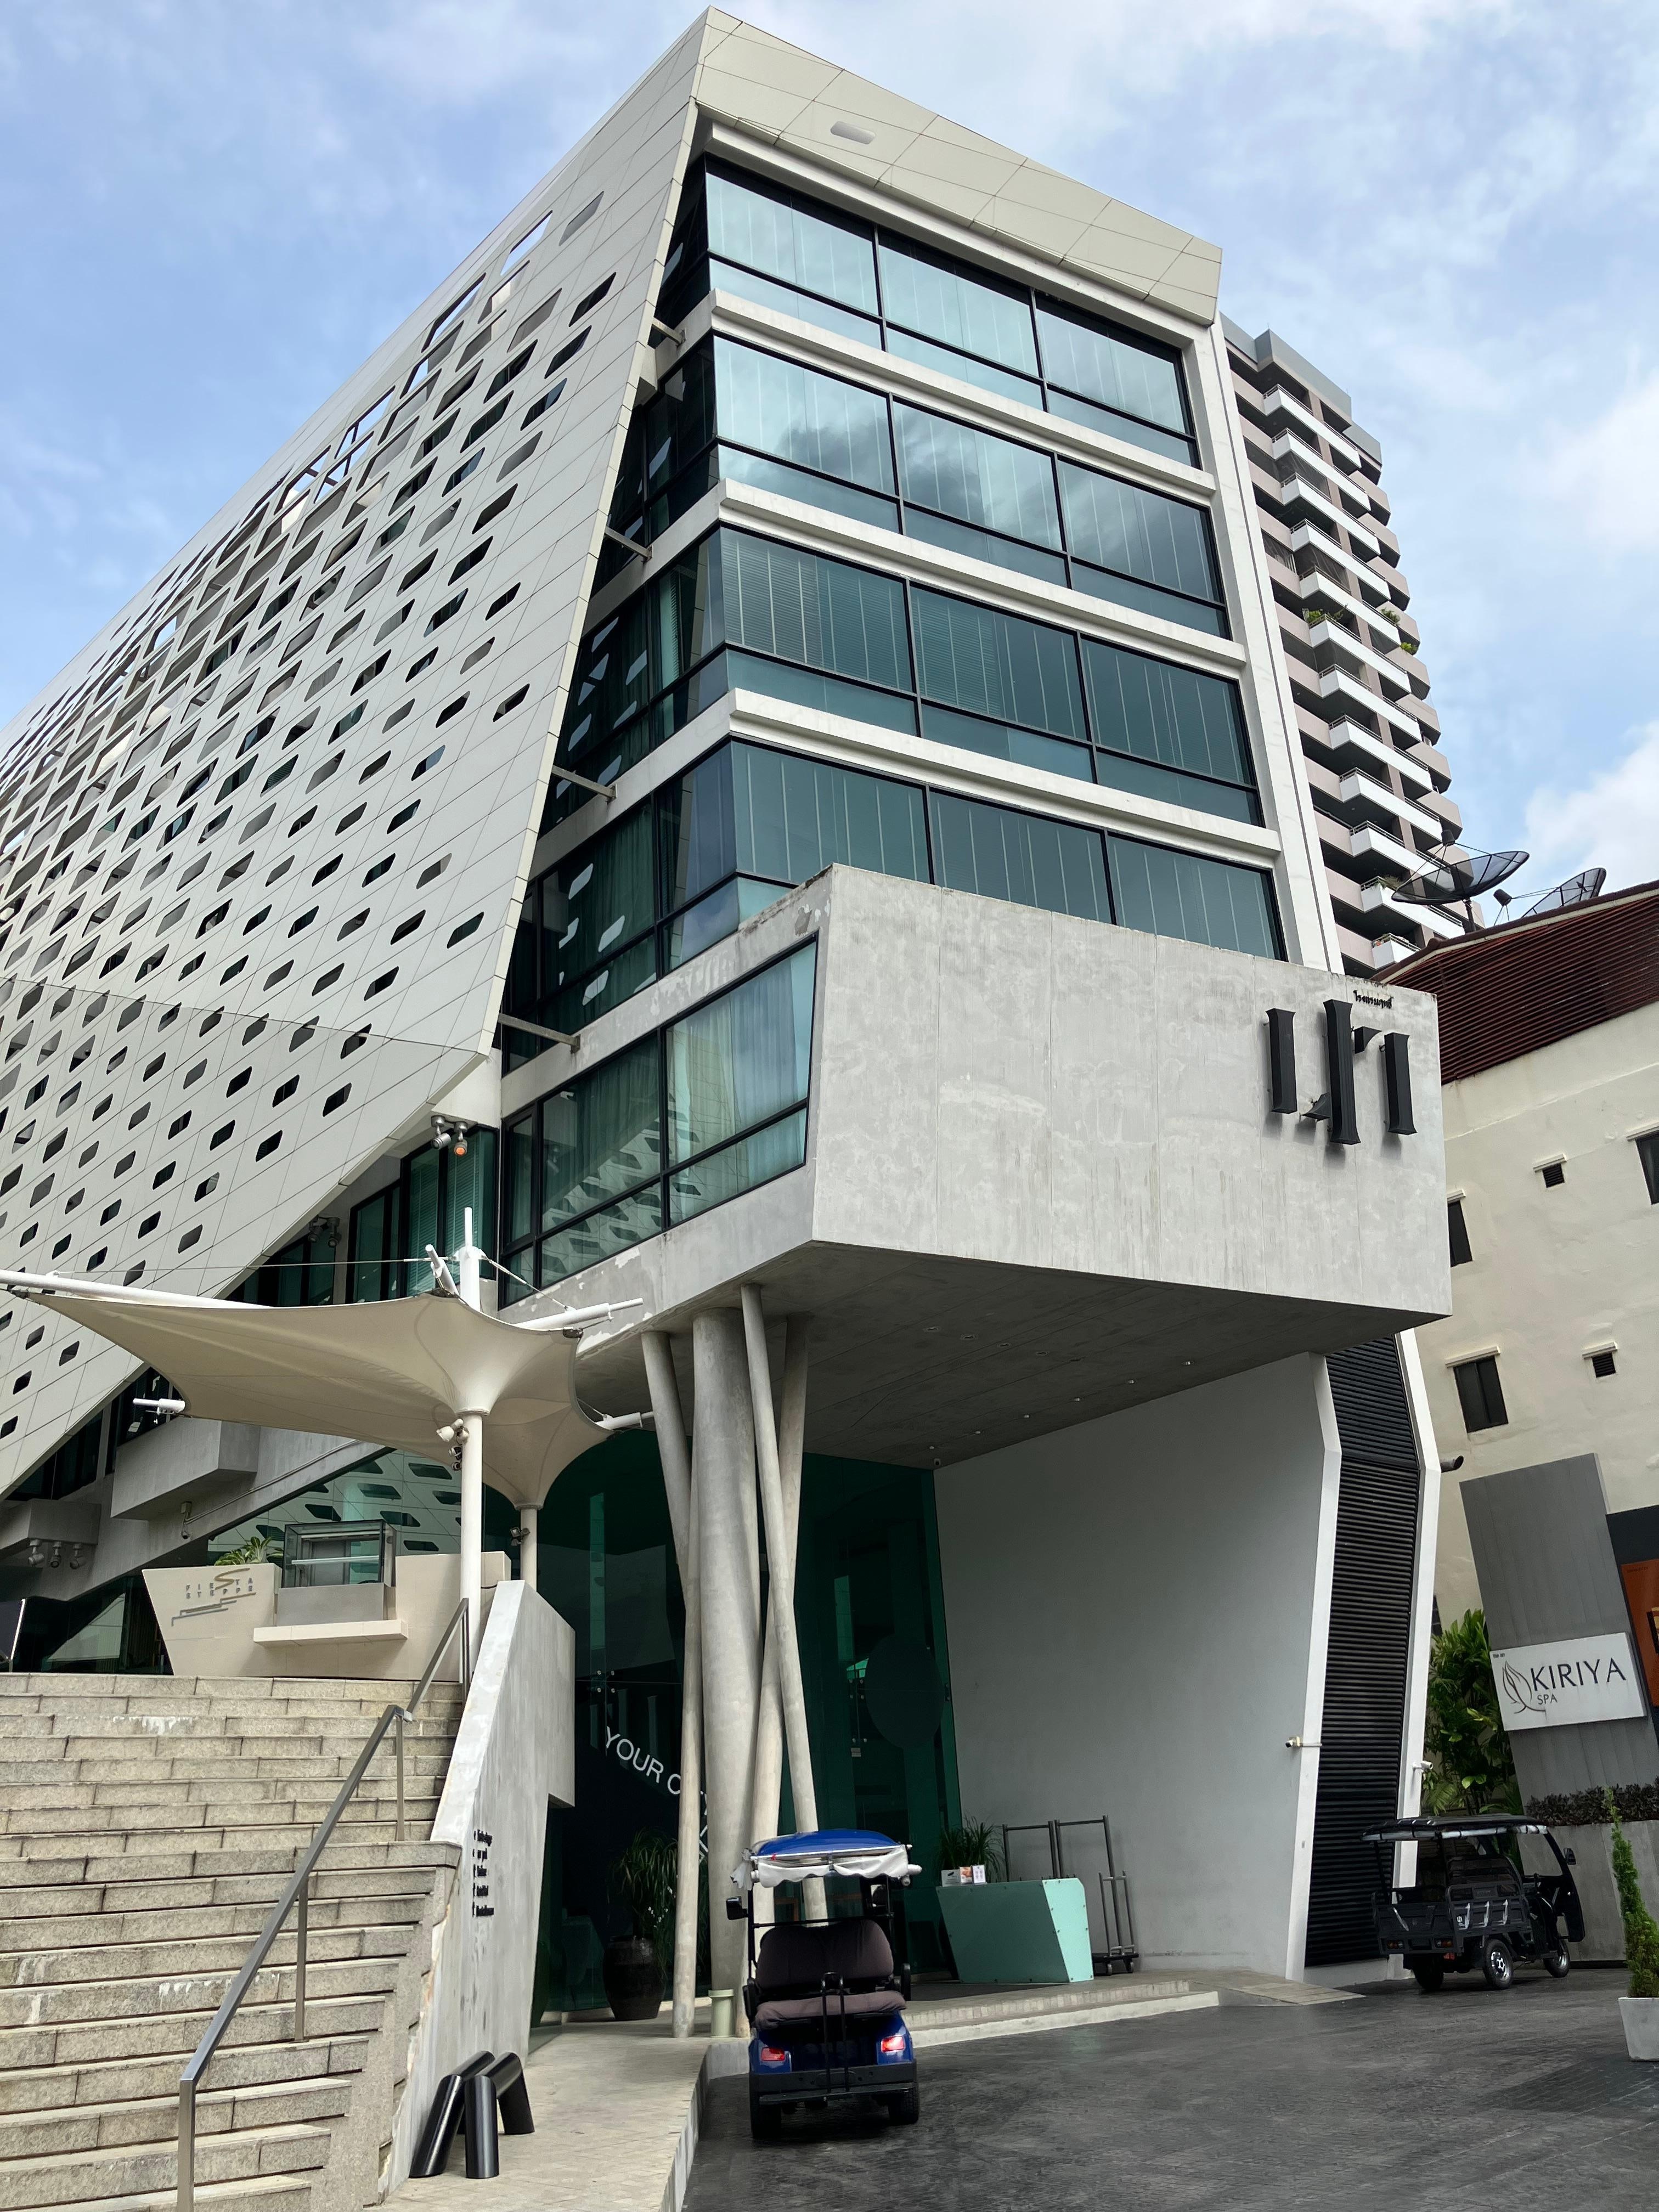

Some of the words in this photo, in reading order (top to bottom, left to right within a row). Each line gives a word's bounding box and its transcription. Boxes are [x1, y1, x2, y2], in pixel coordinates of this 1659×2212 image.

[1530, 1657, 1627, 1692] KIRIYA
[1537, 1694, 1558, 1705] SPA
[606, 1725, 664, 1784] YOUR
